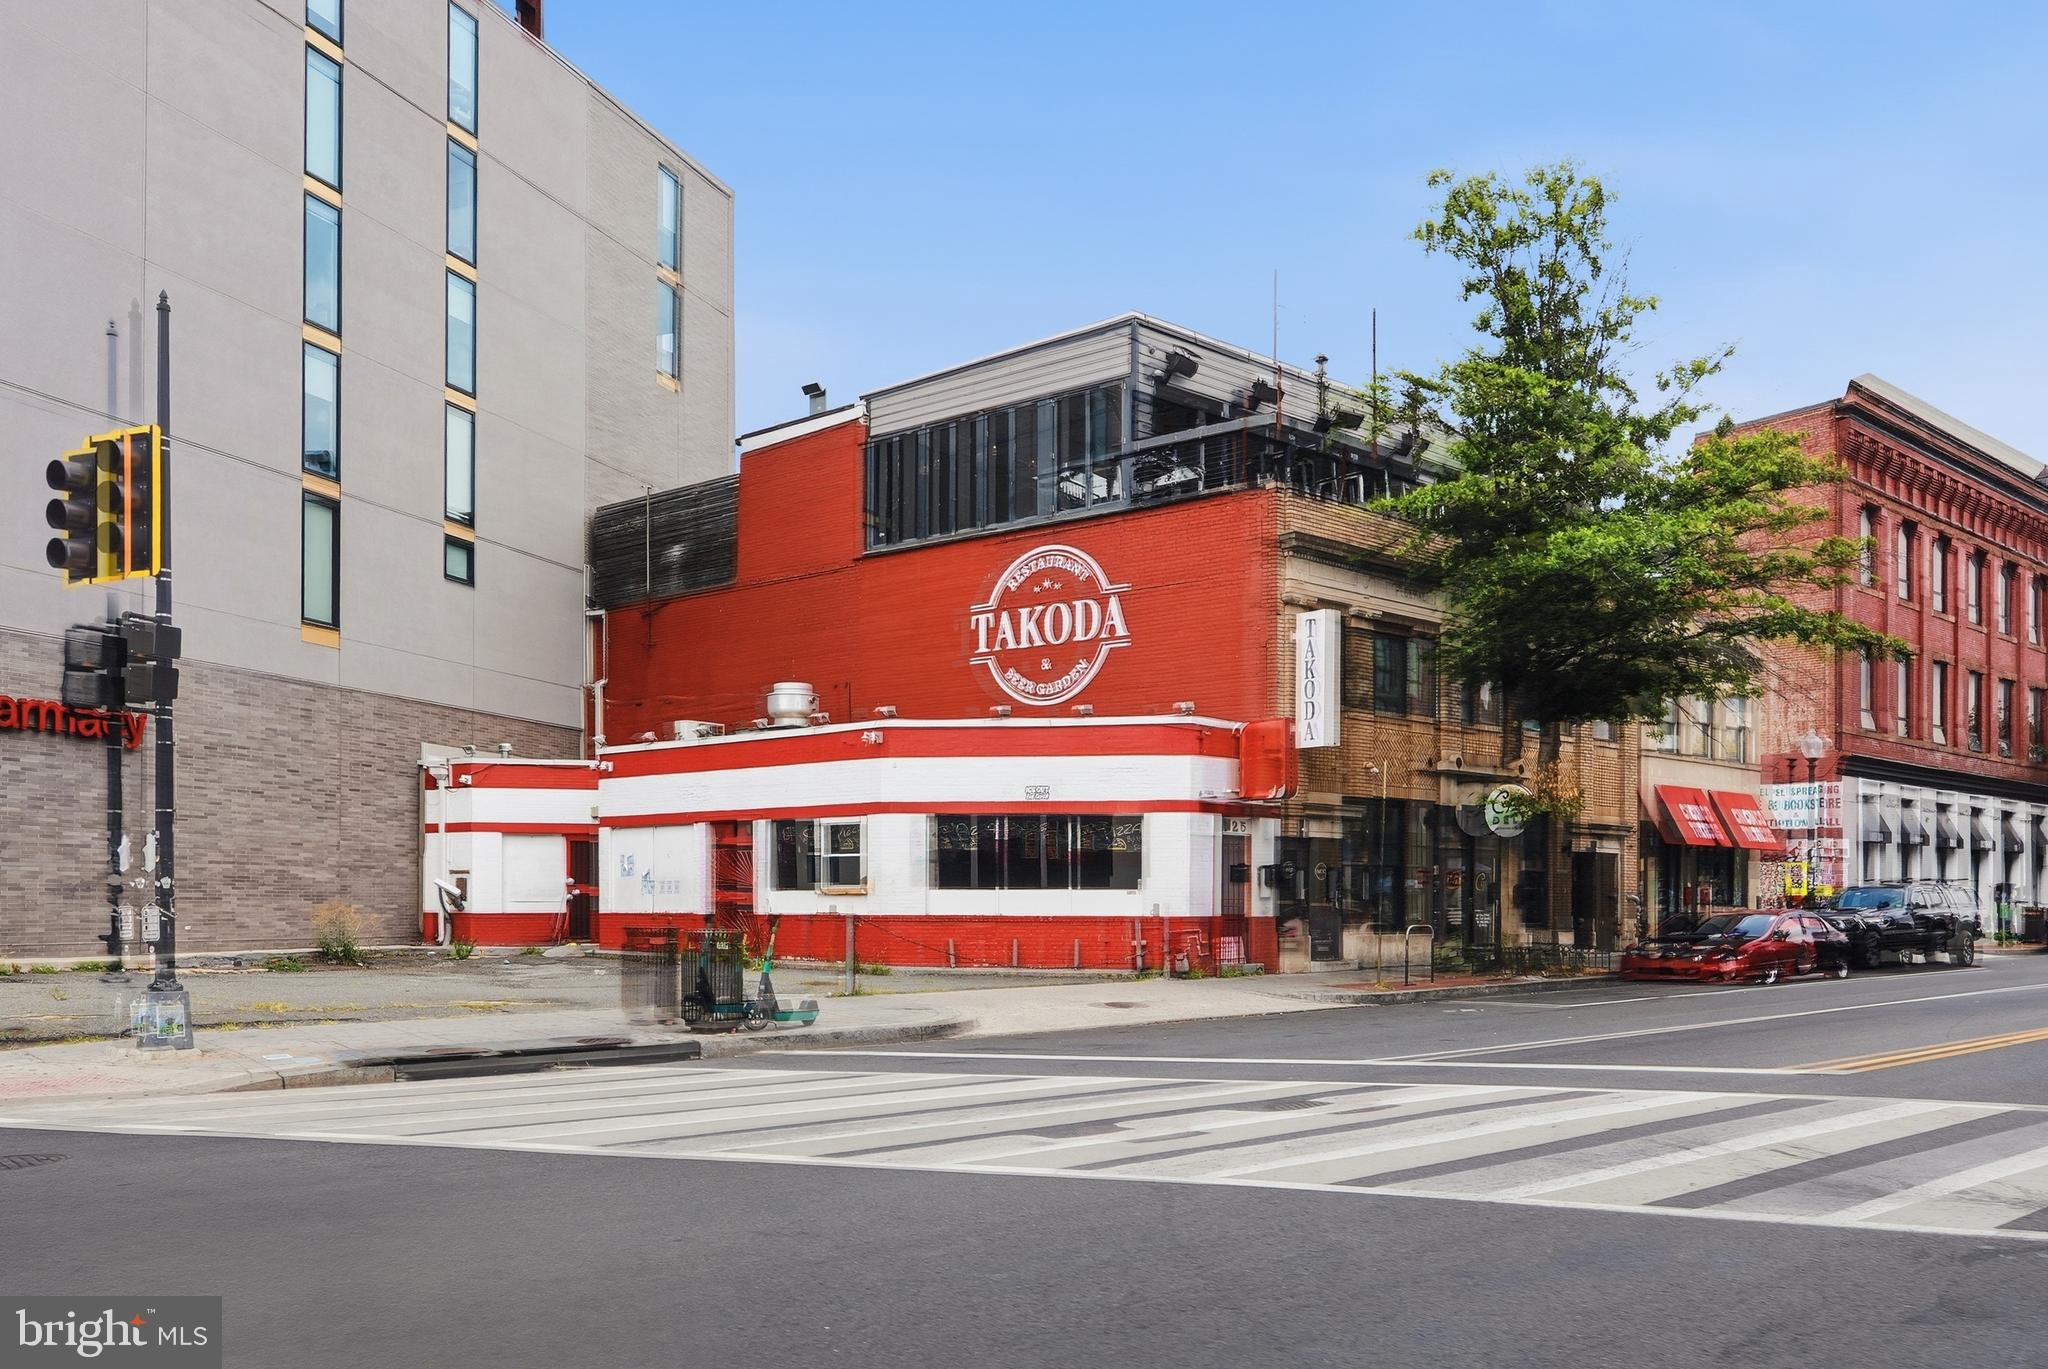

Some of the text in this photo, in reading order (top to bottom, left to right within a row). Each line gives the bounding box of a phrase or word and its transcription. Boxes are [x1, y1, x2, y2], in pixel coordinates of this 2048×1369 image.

[1007, 556, 1091, 592] RESTAURANT
[970, 595, 1131, 654] TAKODA
[1005, 659, 1090, 695] BEER GARDEN
[1304, 618, 1316, 741] TAKODA
[1492, 816, 1522, 826] DEL
